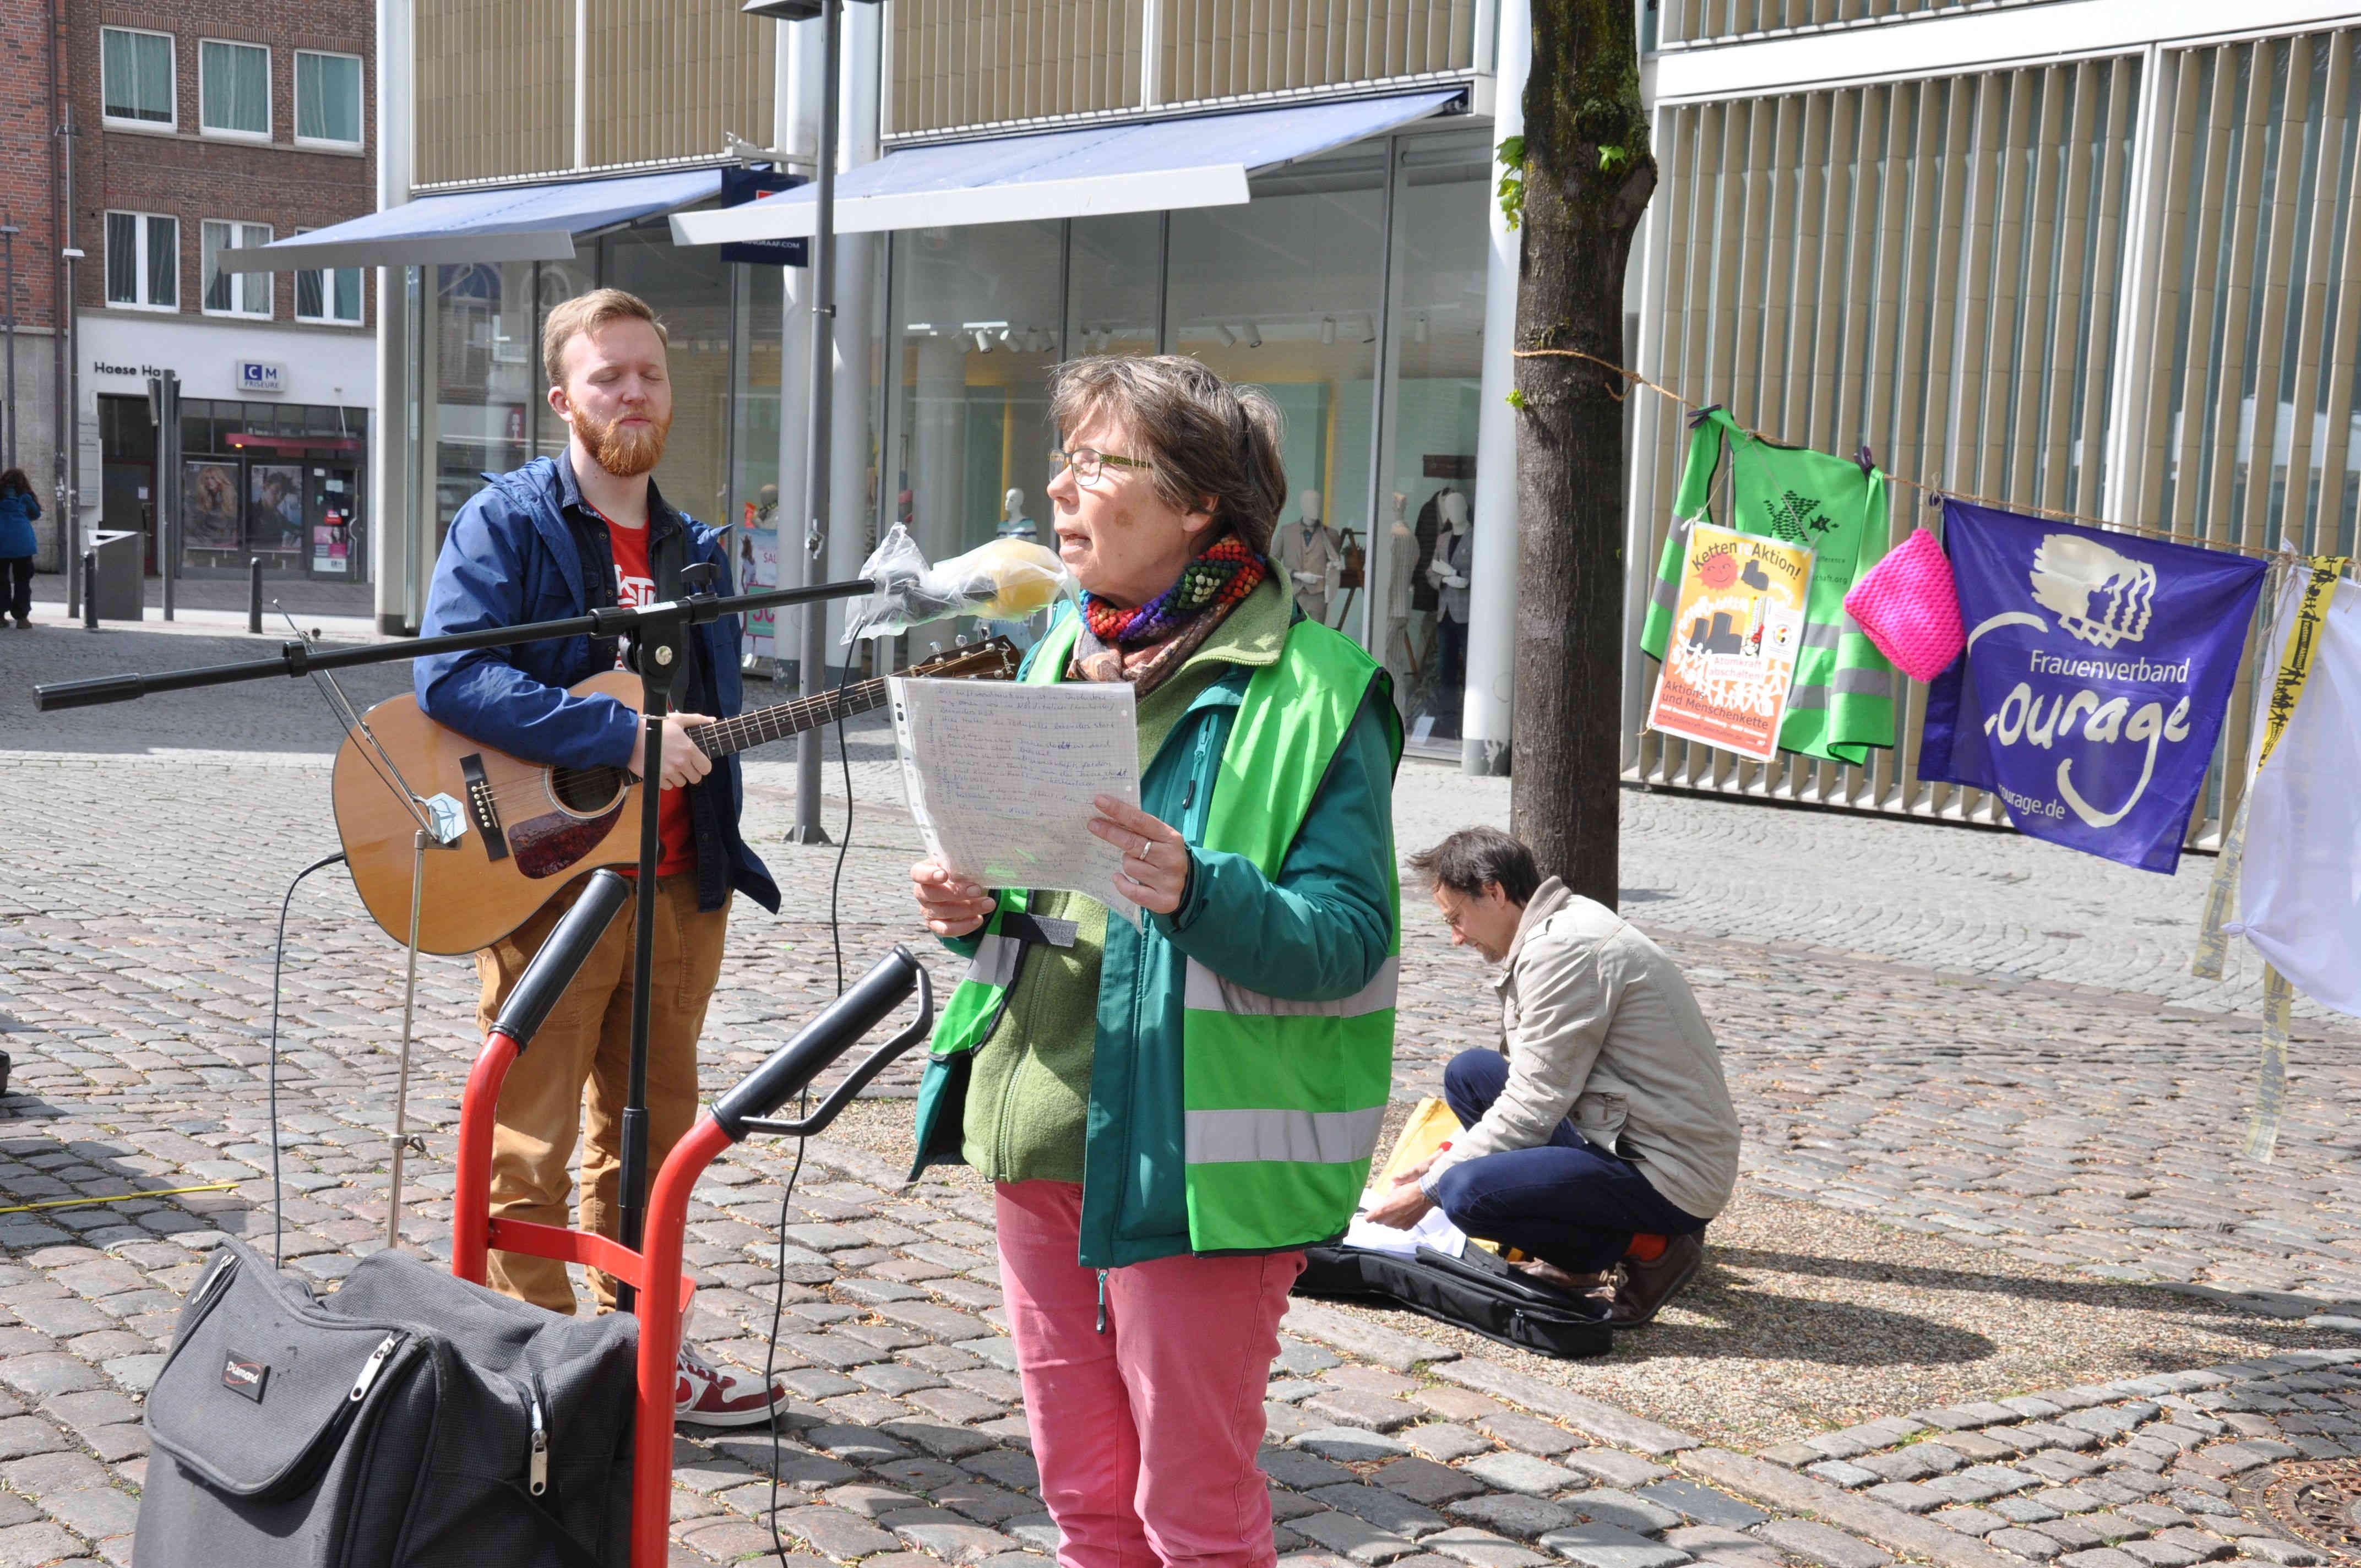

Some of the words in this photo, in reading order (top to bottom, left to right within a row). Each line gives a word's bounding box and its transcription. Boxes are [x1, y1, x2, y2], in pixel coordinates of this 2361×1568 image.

[94, 361, 137, 375] Haese
[142, 364, 176, 377] Has
[2030, 650, 2190, 683] Frauenverband
[1662, 693, 1683, 705] und
[1686, 697, 1769, 729] Menschenkette
[226, 1360, 259, 1384] Diamond
